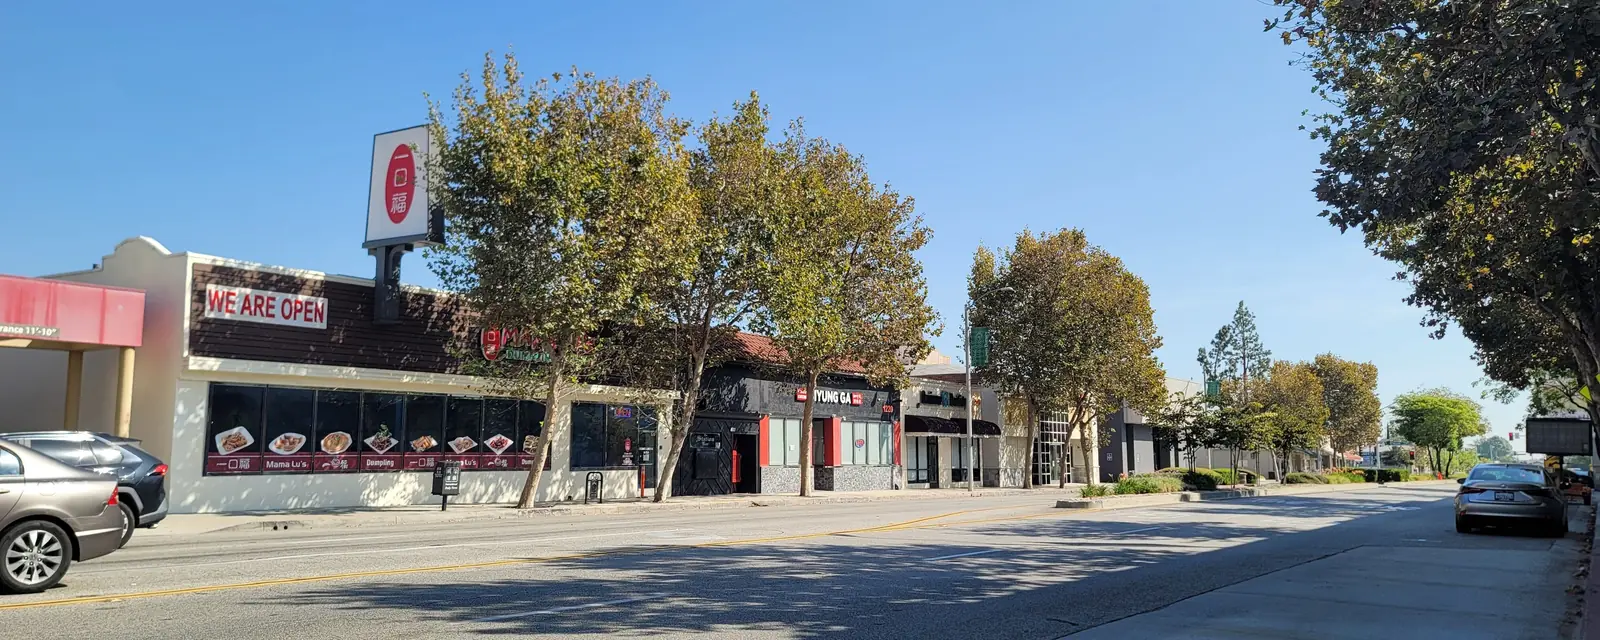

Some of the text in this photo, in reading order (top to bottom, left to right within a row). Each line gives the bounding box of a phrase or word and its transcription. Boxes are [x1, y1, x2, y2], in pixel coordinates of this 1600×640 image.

[390, 153, 409, 215] 一口福
[207, 288, 325, 324] WE ARE OPEN
[839, 391, 851, 405] GA
[266, 460, 307, 469] Mama Lu's
[366, 459, 394, 467] Dumpling
